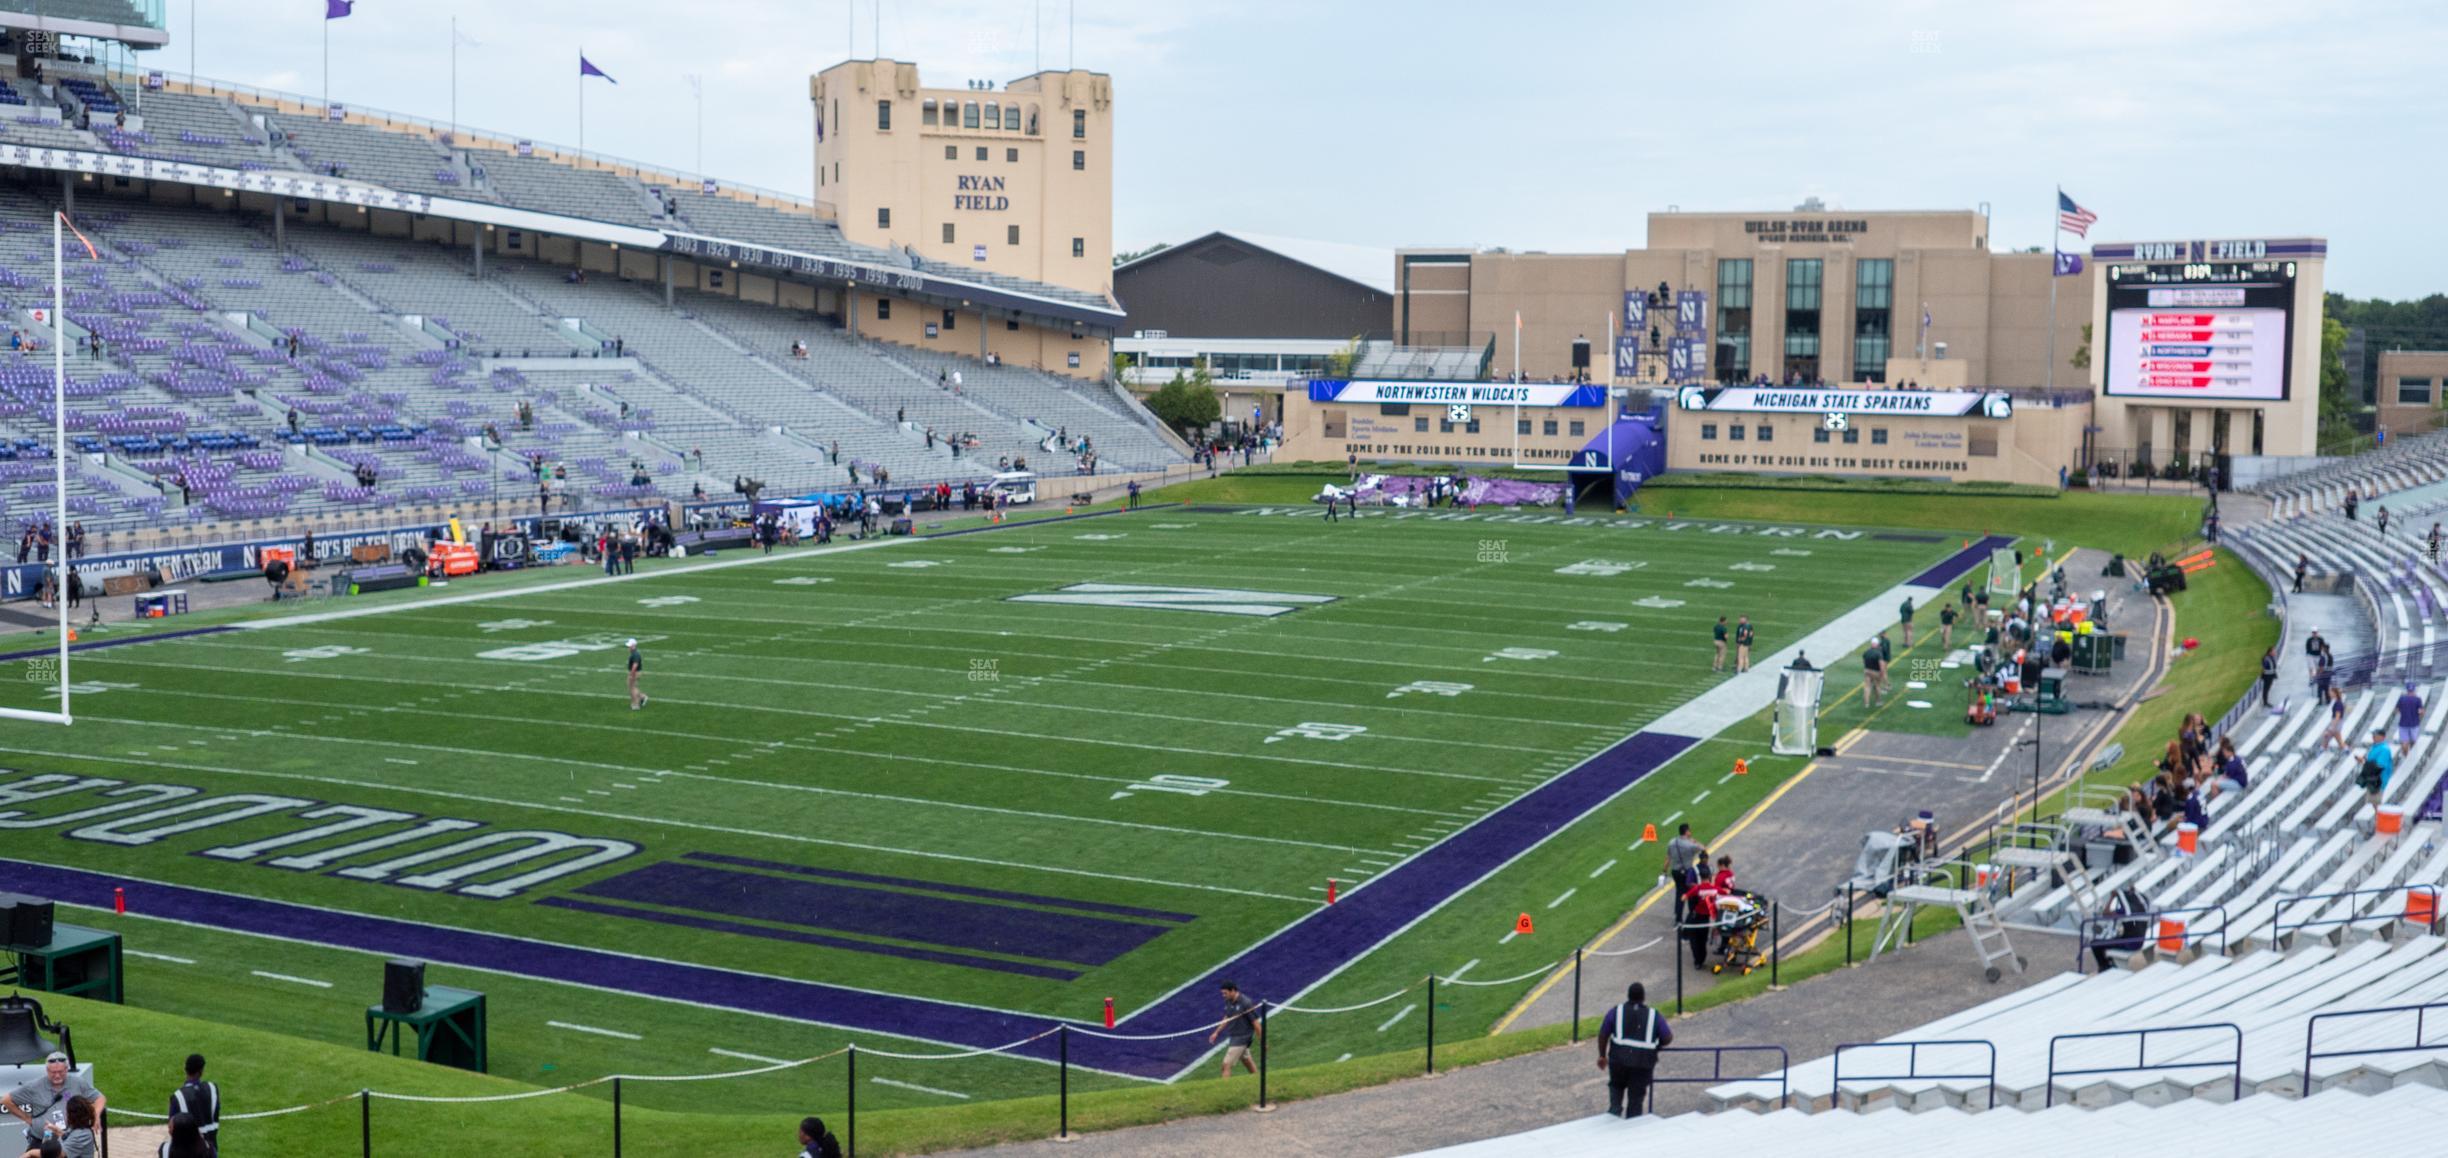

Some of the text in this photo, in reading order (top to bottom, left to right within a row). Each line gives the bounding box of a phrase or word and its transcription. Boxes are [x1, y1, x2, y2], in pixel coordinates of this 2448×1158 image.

[958, 175, 1005, 191] RYAN
[955, 195, 1009, 211] FIELD
[1745, 221, 1868, 233] WELSH-RYAN ARENA
[1789, 234, 1829, 242] MEMORIAL
[2134, 243, 2176, 260] RYAN
[2218, 241, 2266, 259] FIELD
[673, 236, 923, 290] 1903 1926 1930 1931 1936 1995 1996 2000
[1629, 301, 1642, 321] N
[1681, 302, 1695, 322] N
[1619, 347, 1633, 367] N
[1673, 348, 1687, 369] N
[1375, 385, 1467, 400] NORTHWESTERN
[1753, 393, 1932, 410] MICHIGAN STATE SPARTANS
[1451, 405, 1467, 420] 25
[1826, 412, 1845, 429] 25
[1346, 444, 1373, 455] HOME
[1377, 445, 1389, 454] OF
[1393, 445, 1412, 455] THE
[1416, 446, 1440, 455] 2018
[1445, 446, 1461, 456] BIG
[1466, 447, 1486, 457] TEN
[1700, 453, 1968, 472] HOME OF THE 2018 BIG TEN WEST CHAMPIONS
[243, 545, 256, 568] N
[7, 568, 21, 594] N
[1277, 721, 1367, 741] 20
[1127, 774, 1231, 797] 10
[1521, 918, 1530, 928] G
